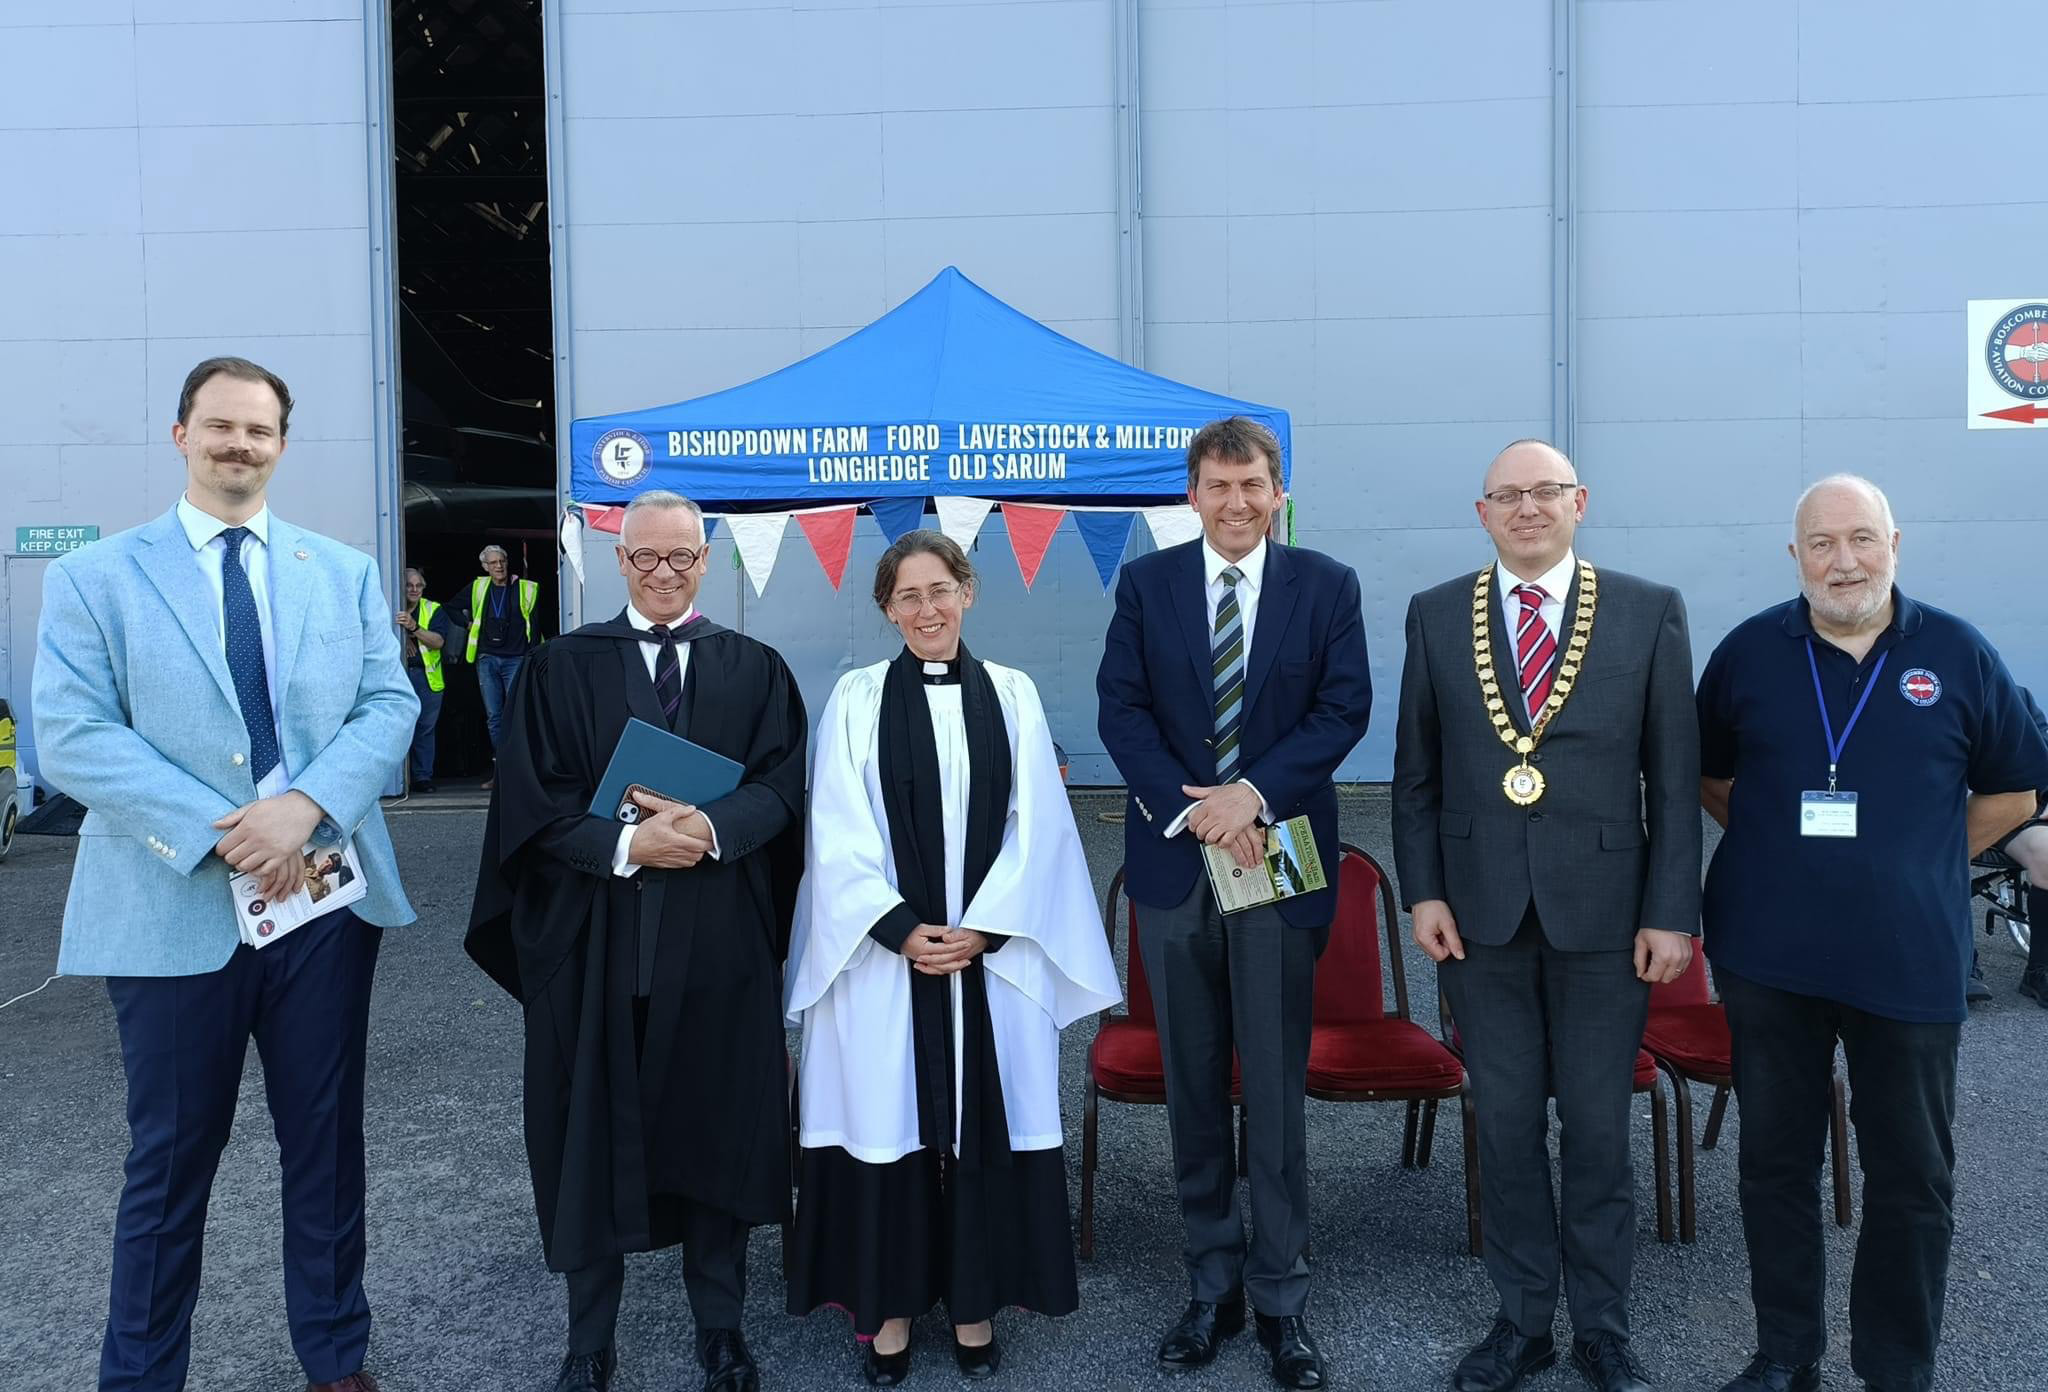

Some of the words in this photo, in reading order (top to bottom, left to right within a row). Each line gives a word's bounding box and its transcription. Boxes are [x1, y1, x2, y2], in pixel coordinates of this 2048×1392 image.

[1994, 309, 2047, 346] BOSCOMBE
[1992, 350, 2025, 393] AVIATION
[2028, 384, 2048, 395] CO
[668, 429, 807, 457] BISHOPDOWN
[812, 427, 868, 454] FARM
[887, 424, 940, 451] FORD
[959, 424, 1090, 450] LAVERSTOCK
[1095, 424, 1110, 449] &
[808, 455, 930, 483] LONGHEDGE
[948, 454, 987, 481] OLD
[992, 453, 1066, 480] SARUM
[20, 541, 52, 552] KEEP
[29, 528, 54, 539] FIRE
[57, 528, 85, 539] EXIT
